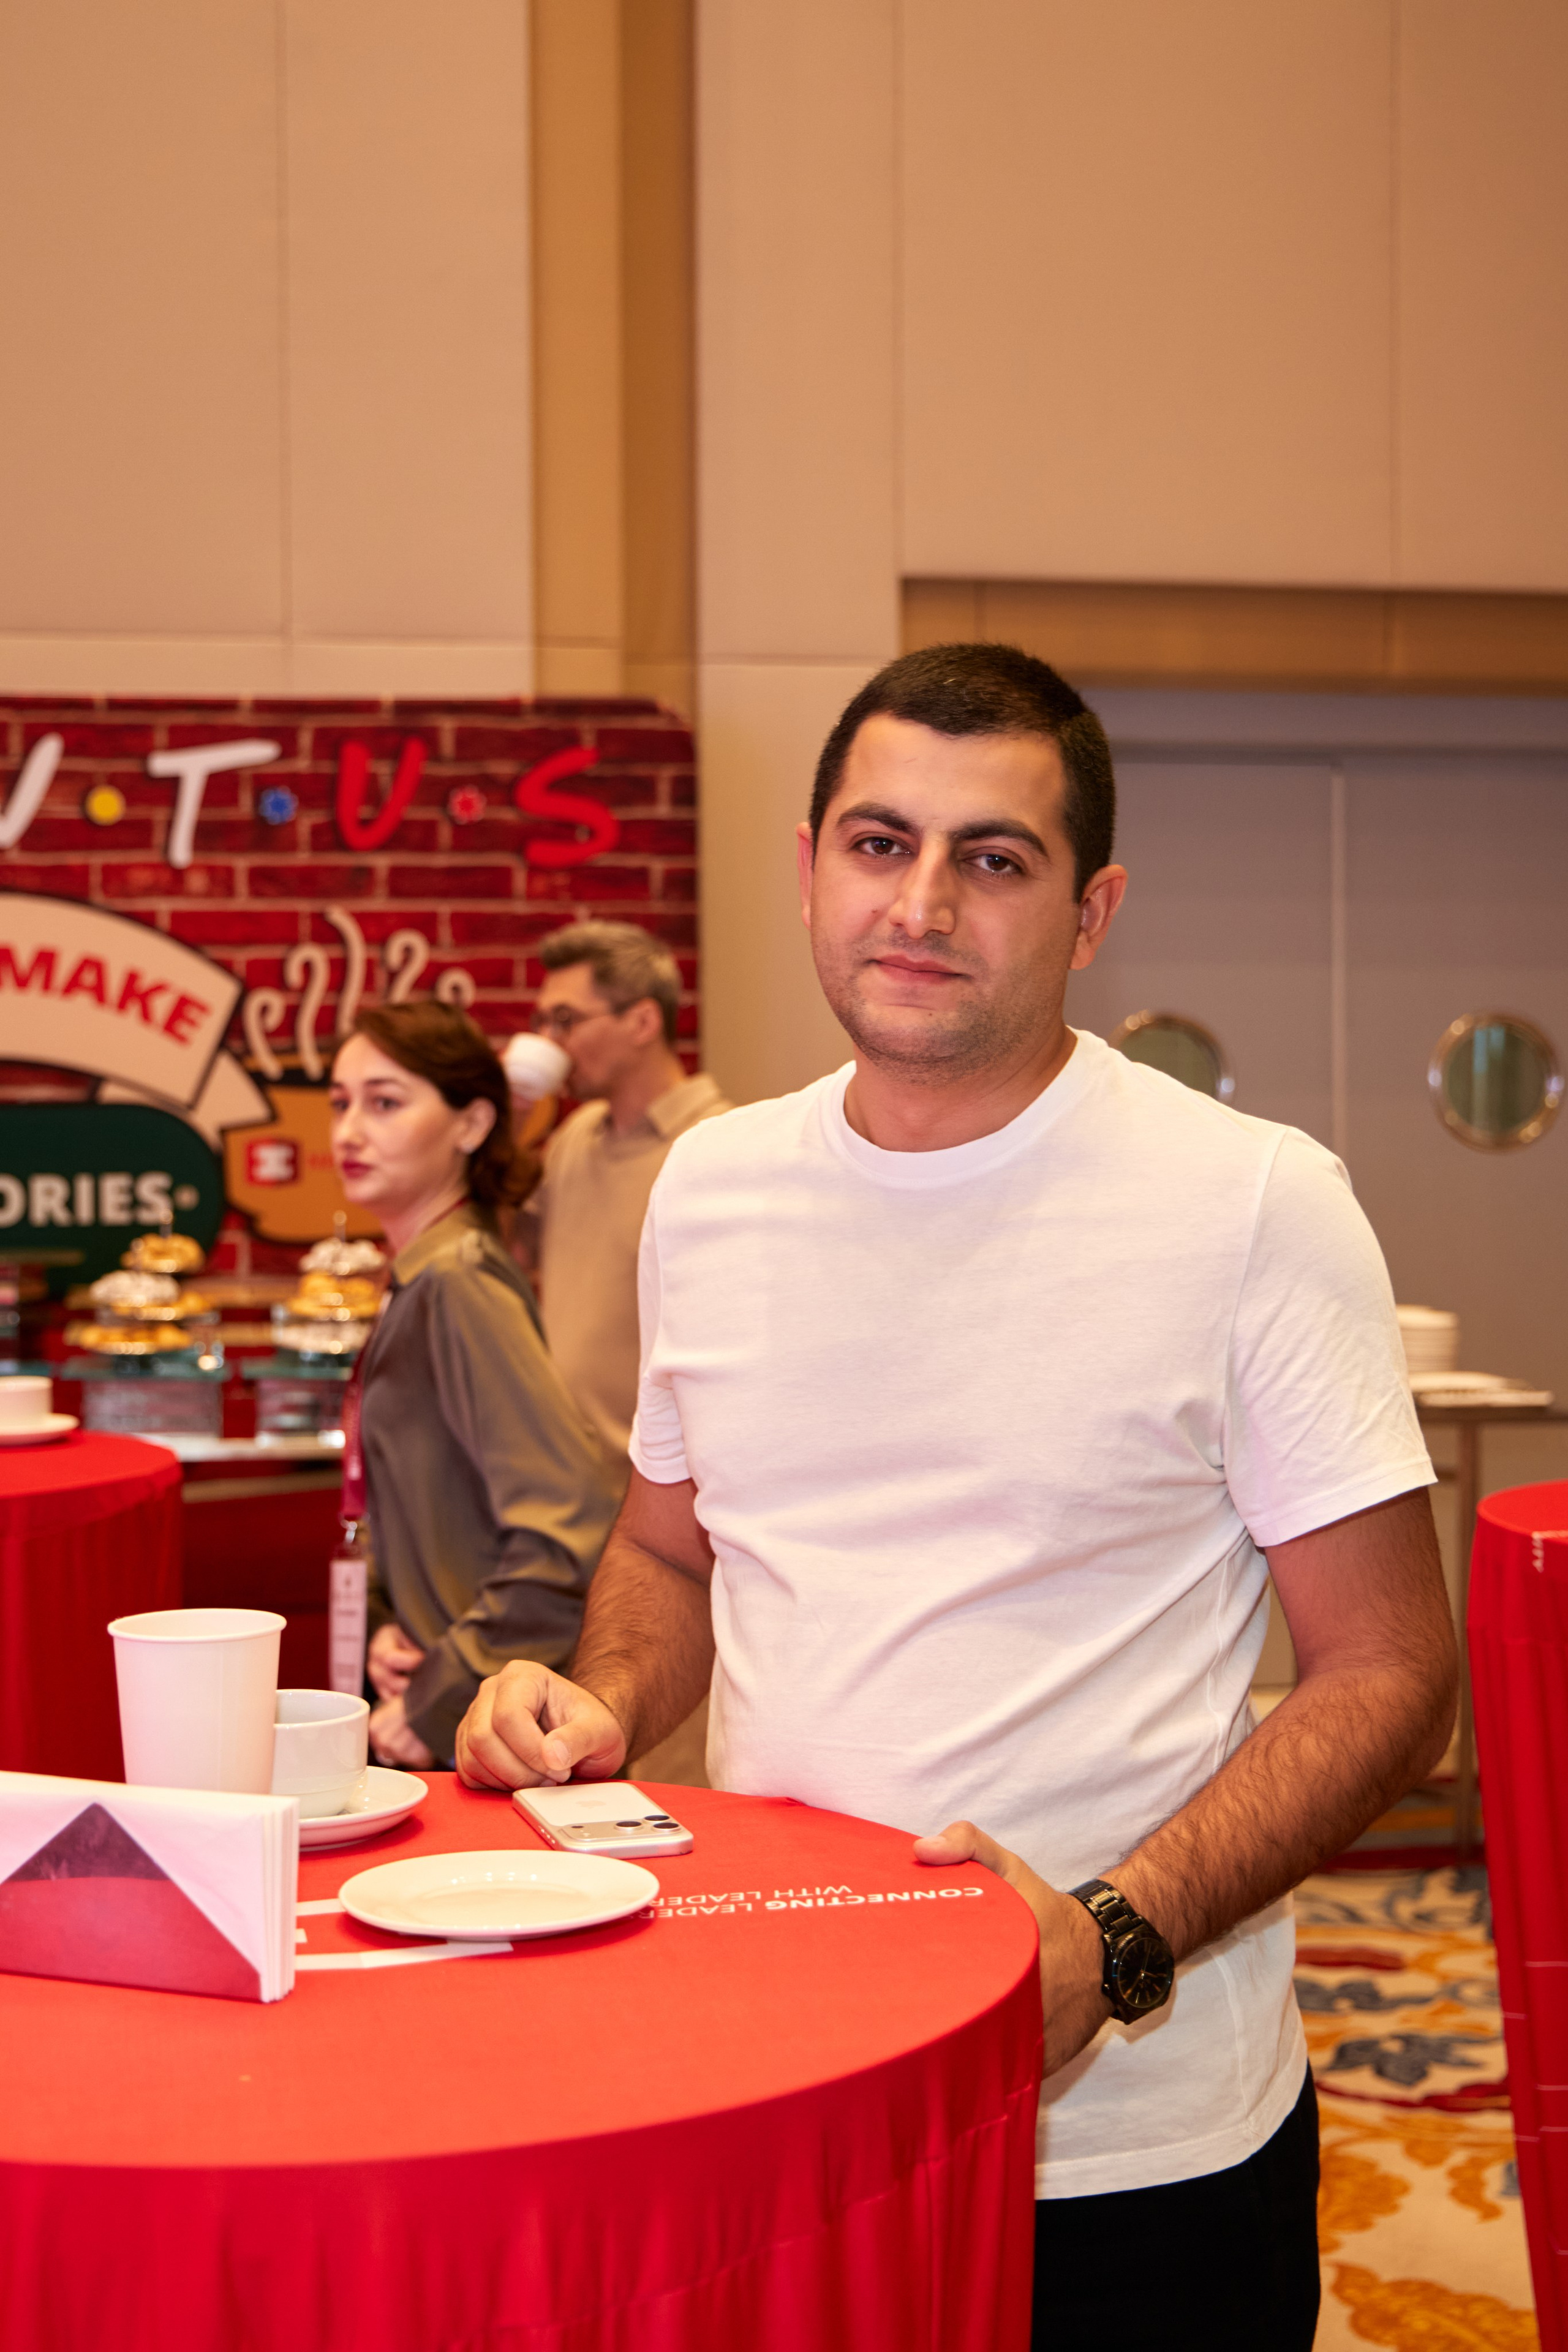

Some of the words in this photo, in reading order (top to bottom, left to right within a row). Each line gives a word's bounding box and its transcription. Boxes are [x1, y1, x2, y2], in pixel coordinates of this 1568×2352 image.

[0, 945, 212, 1046] MAKE
[765, 1887, 984, 1910] CONNECTING
[774, 1885, 853, 1899] WITH
[626, 1902, 753, 1919] LEADER
